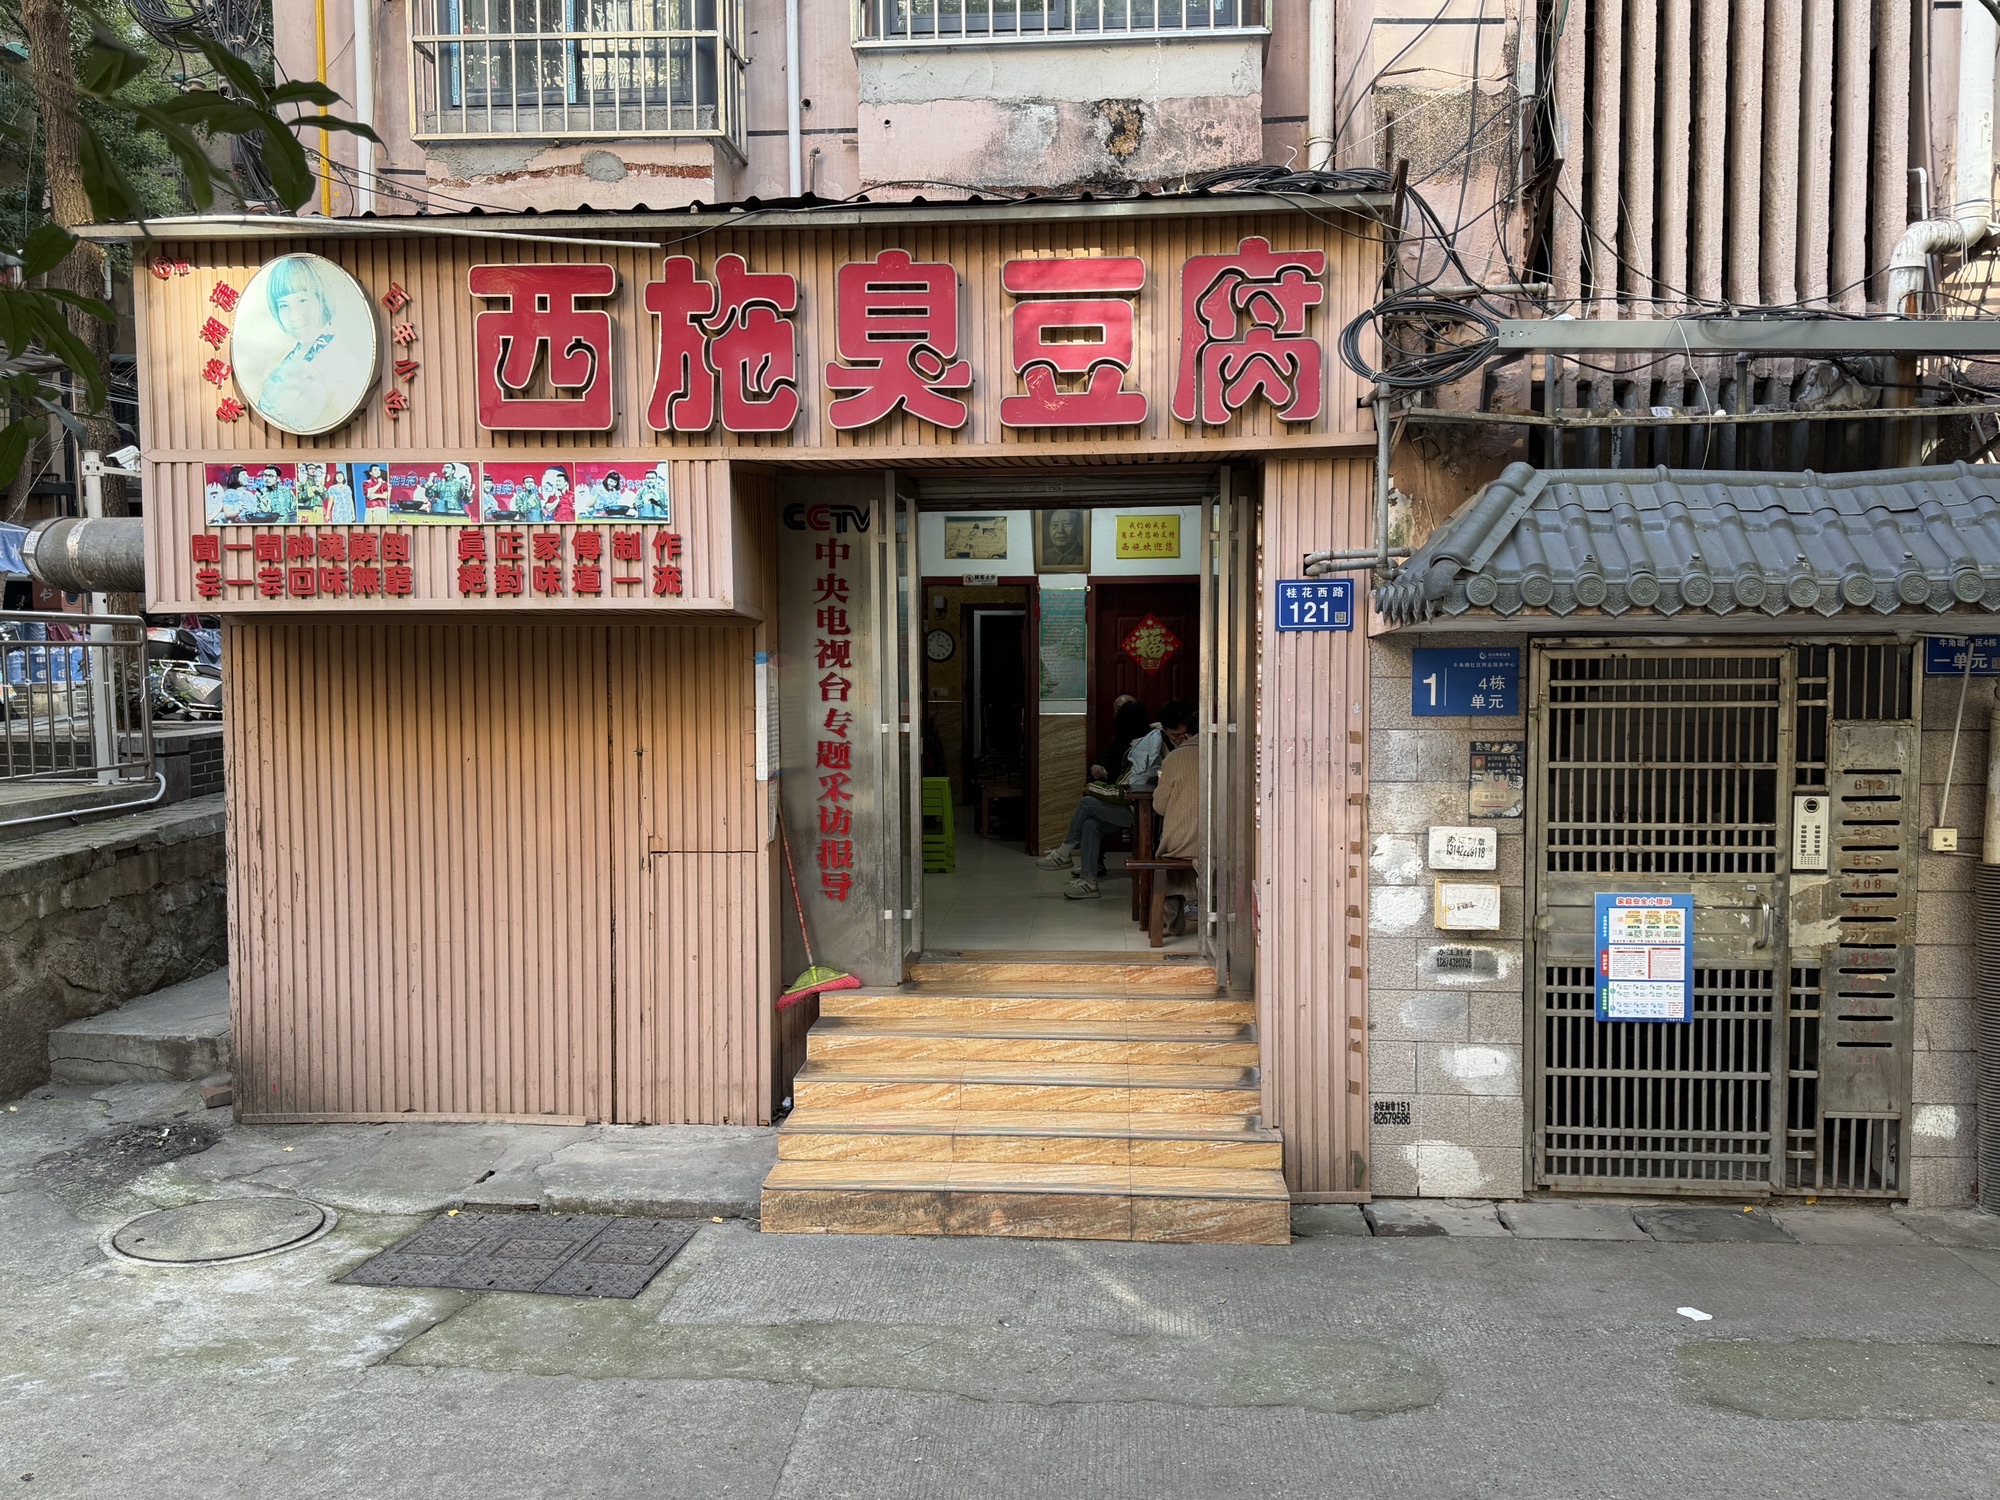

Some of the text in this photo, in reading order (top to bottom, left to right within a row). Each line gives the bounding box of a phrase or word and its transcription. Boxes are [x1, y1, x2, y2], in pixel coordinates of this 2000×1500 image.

[467, 234, 1327, 433] 西施臭豆腐
[381, 281, 420, 420] 百年小吃
[783, 503, 870, 534] CCTV
[1128, 521, 1168, 530] 我们的成长
[1121, 541, 1175, 552] 西施欢迎您
[1285, 586, 1345, 598] 桂花西路
[1289, 601, 1330, 623] 121
[1423, 673, 1436, 706] 1
[1478, 675, 1505, 690] 4栋
[1470, 694, 1504, 709] 单元
[811, 537, 854, 902] 中央电视台专题采访报导
[1852, 879, 1882, 889] 408
[1617, 897, 1672, 906] 家庭安全小提示
[1373, 1111, 1411, 1125] 62679586
